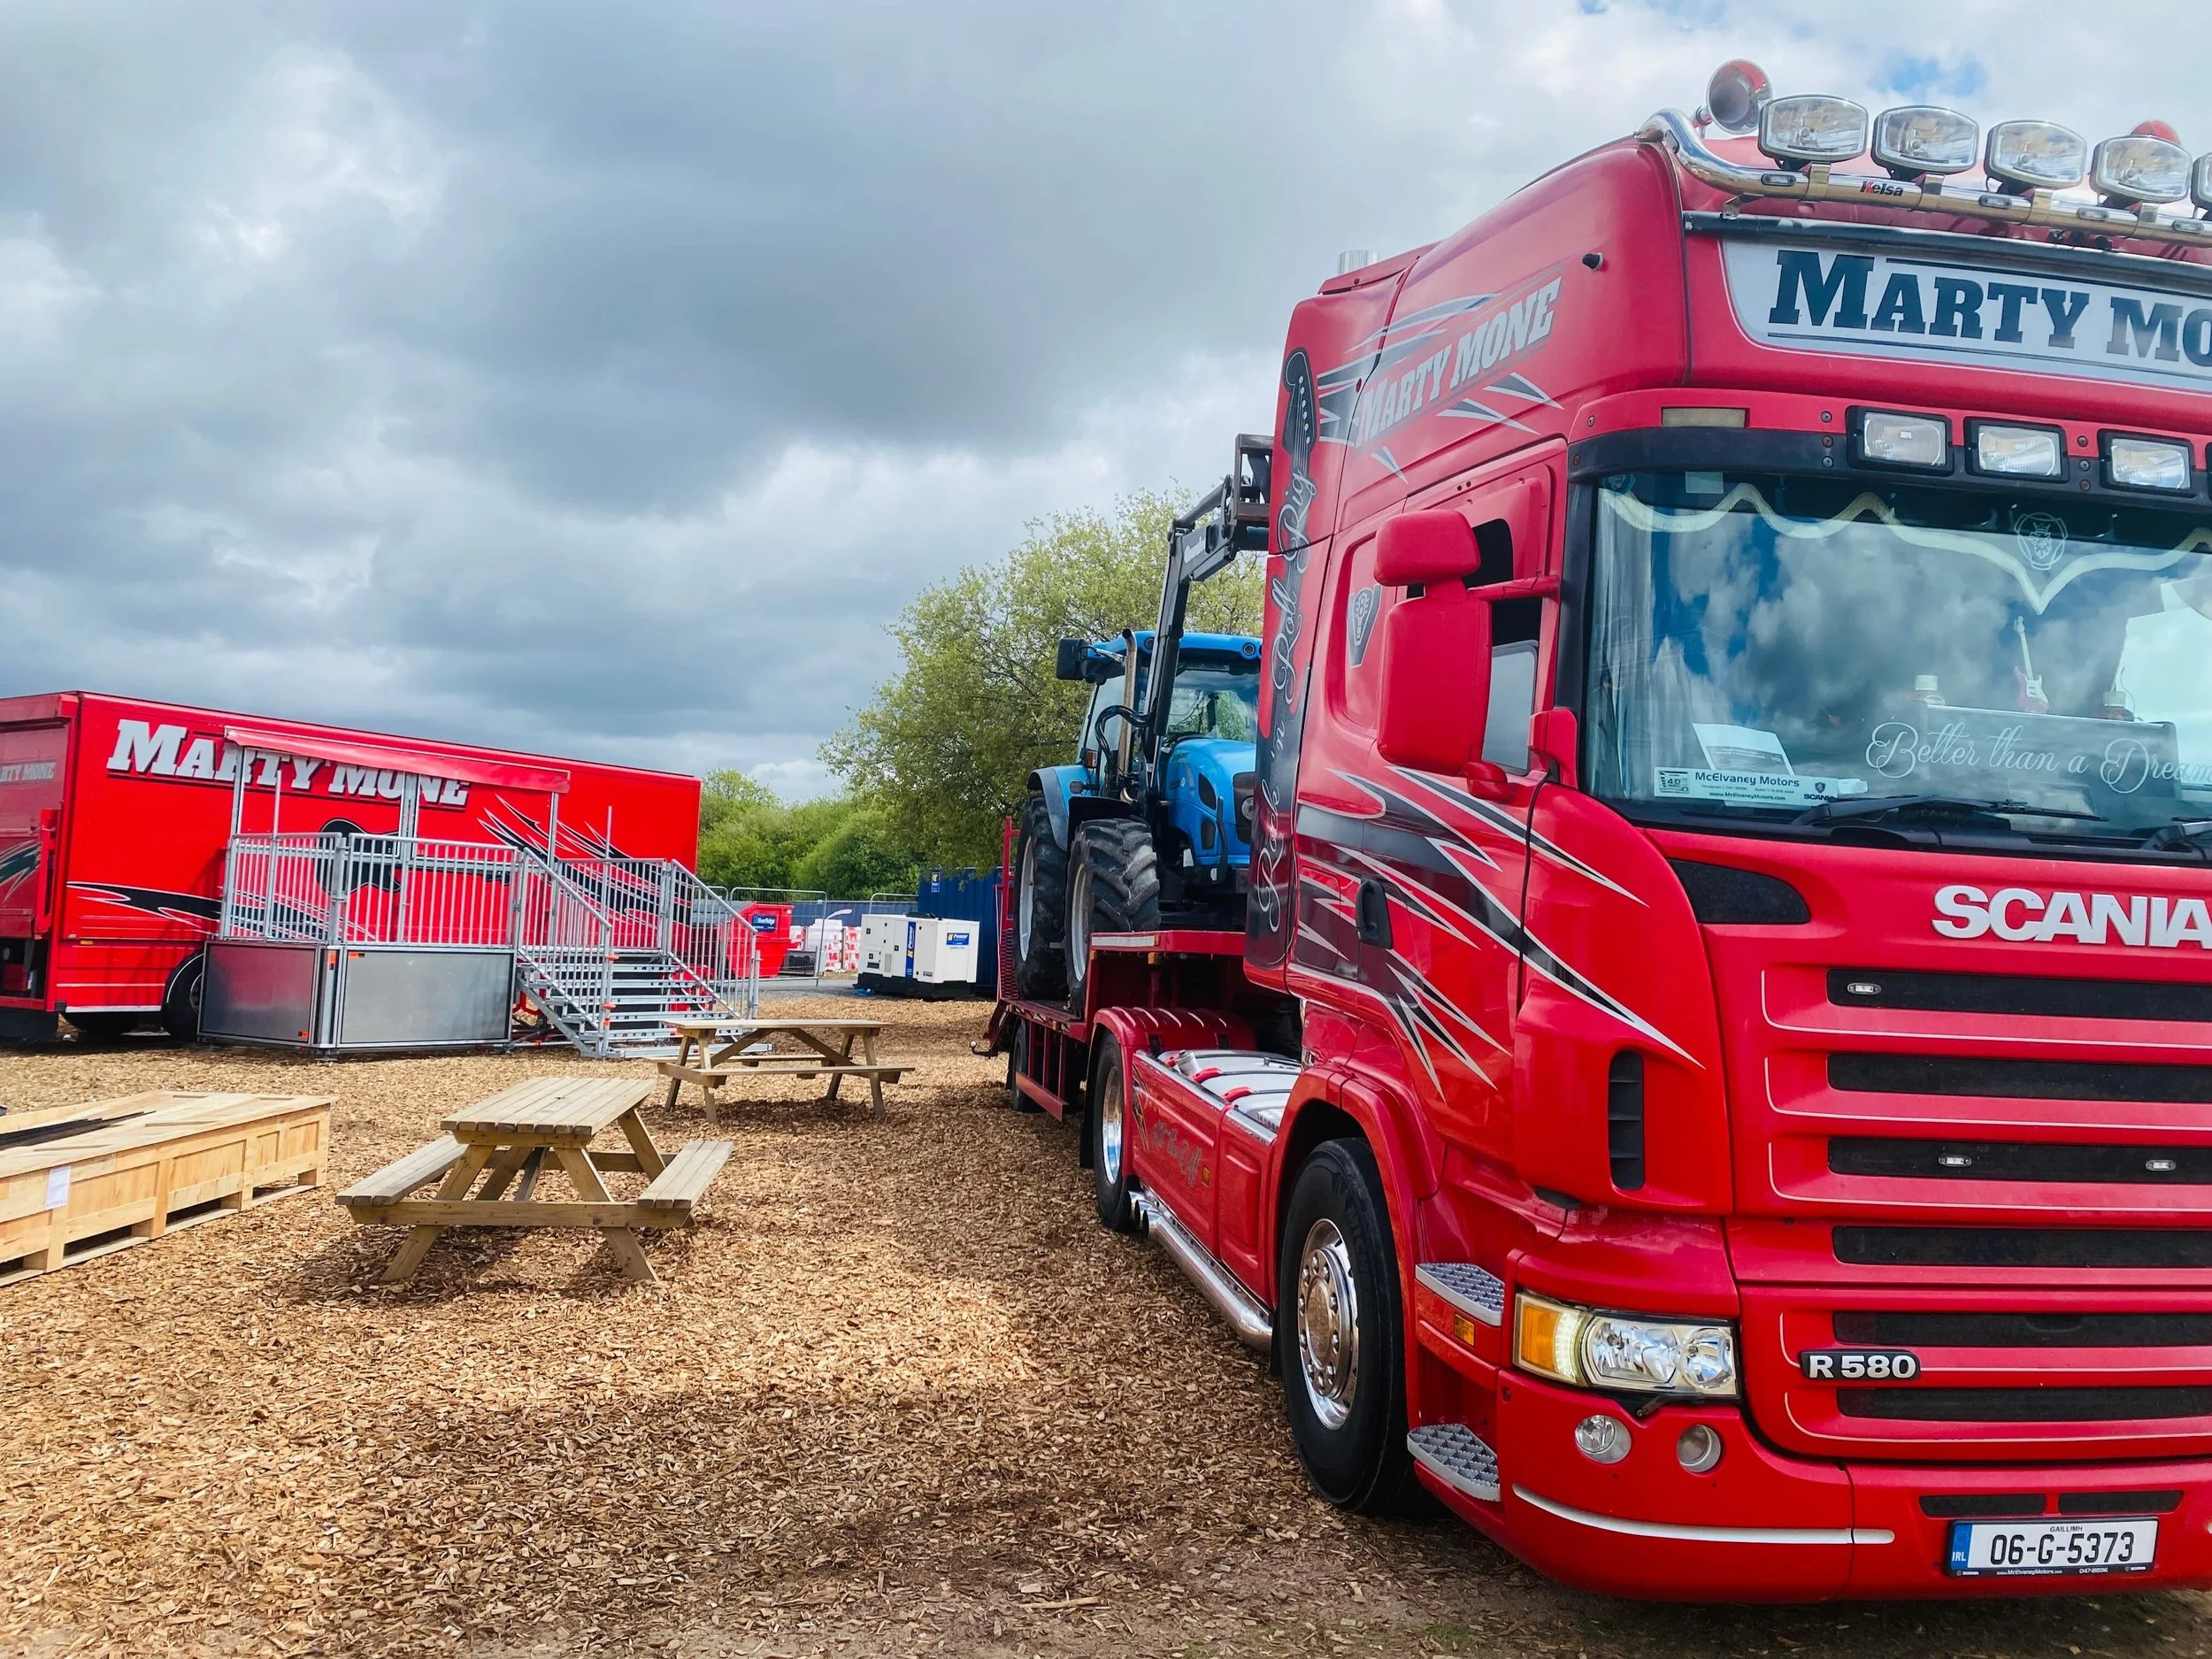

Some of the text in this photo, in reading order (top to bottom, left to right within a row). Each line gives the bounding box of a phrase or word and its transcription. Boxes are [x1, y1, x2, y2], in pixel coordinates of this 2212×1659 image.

[1769, 250, 2090, 349] MARTY
[1355, 277, 1562, 449] MARTY MONE
[1278, 469, 1317, 573] Rig
[1271, 577, 1303, 704] Roll
[106, 718, 331, 790] MARTY
[1694, 772, 1756, 786] McElvaney
[1759, 775, 1800, 787] Motors
[1865, 721, 1981, 779] Better
[1985, 725, 2060, 772] than
[2068, 752, 2090, 773] a
[1256, 779, 1285, 933] Rock
[1932, 885, 2212, 949] SCANIA
[1809, 1355, 1916, 1379] R 580
[1952, 1550, 1967, 1562] IRL
[1990, 1532, 2135, 1565] 06-G-5373
